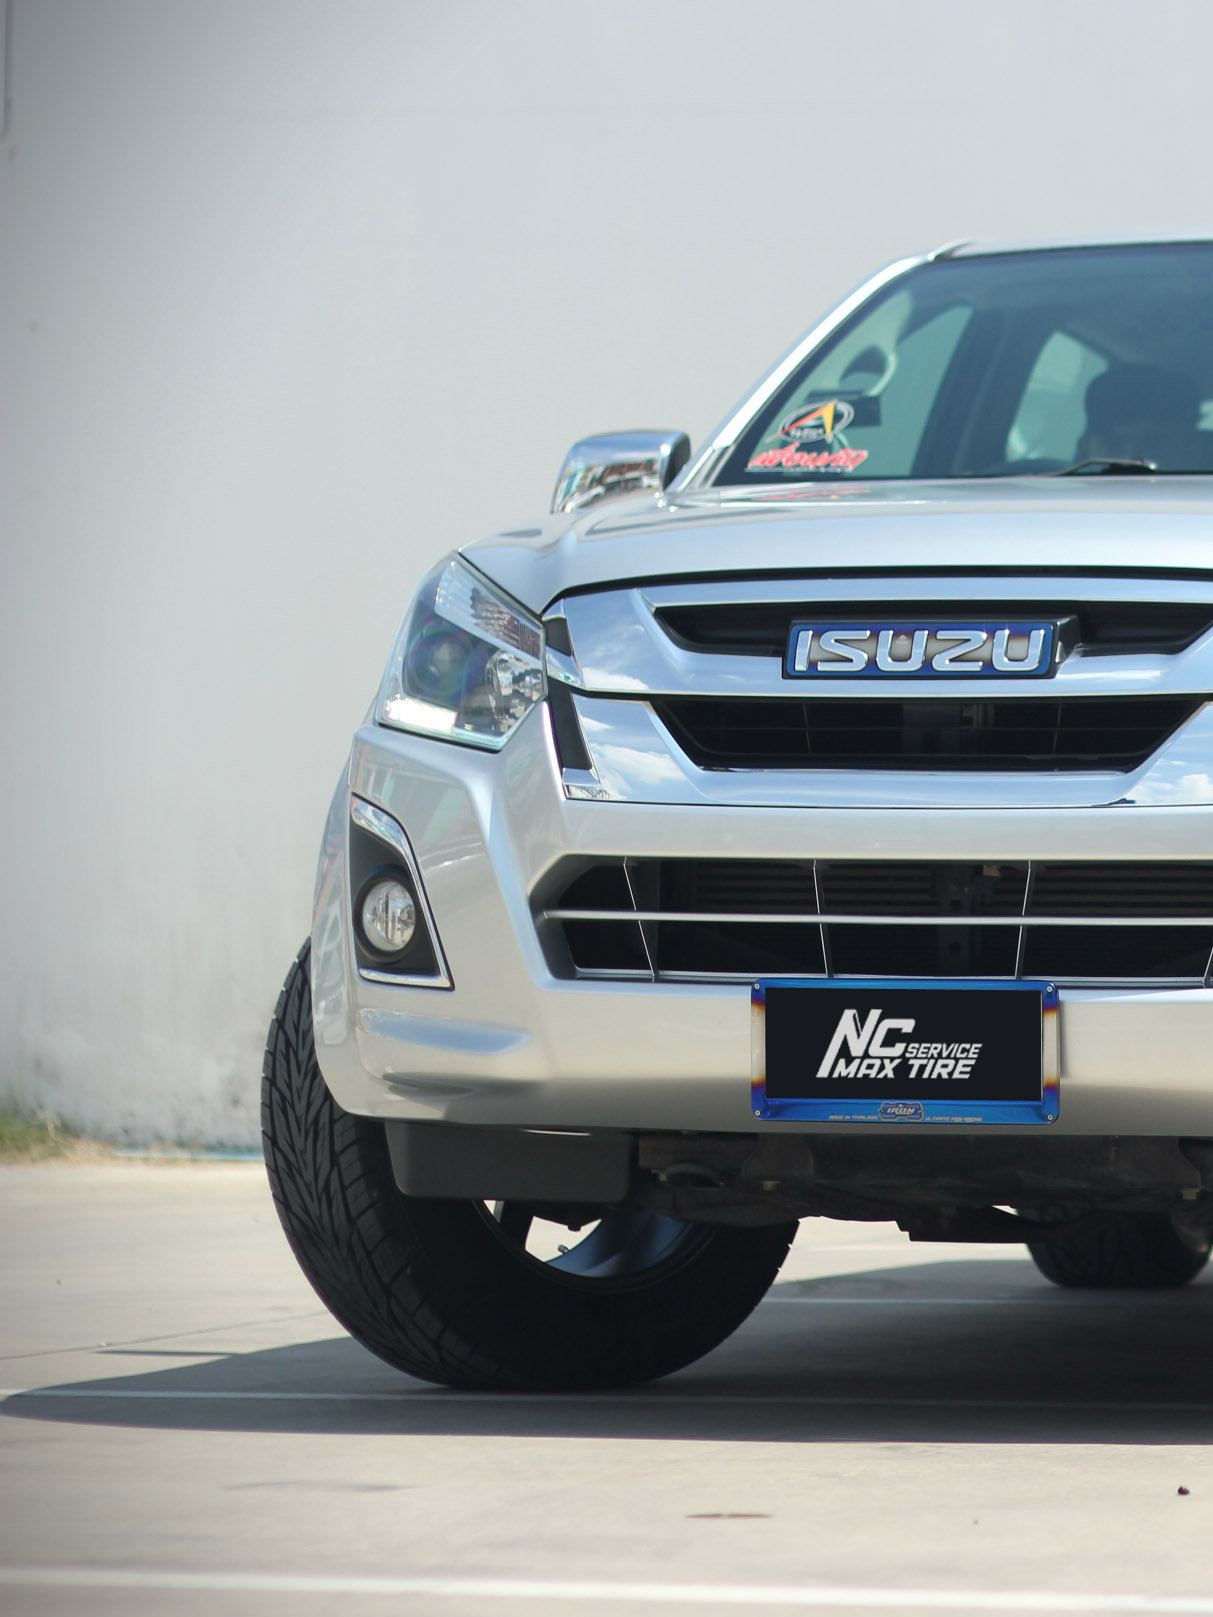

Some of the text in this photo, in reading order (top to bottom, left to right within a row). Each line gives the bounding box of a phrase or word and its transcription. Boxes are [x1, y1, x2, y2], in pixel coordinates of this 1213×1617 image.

[794, 629, 1046, 672] ISUZU
[816, 1009, 983, 1078] NC SERVICE
[832, 1058, 976, 1079] MAX TIRE
